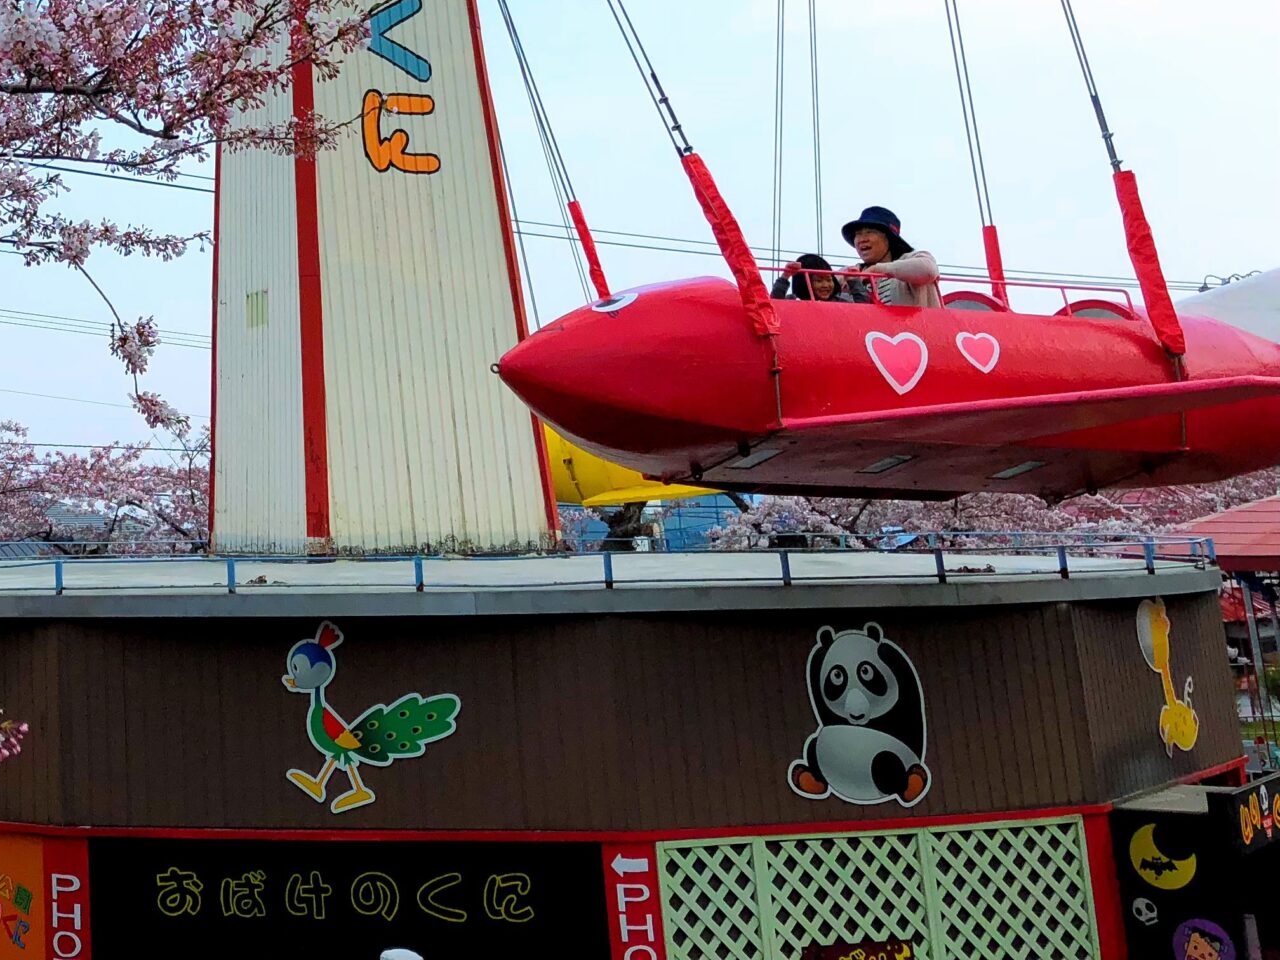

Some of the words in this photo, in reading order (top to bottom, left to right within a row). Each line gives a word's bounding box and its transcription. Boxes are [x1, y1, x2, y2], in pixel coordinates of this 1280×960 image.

[51, 873, 82, 960] PHO
[156, 867, 534, 922] おばけのくに
